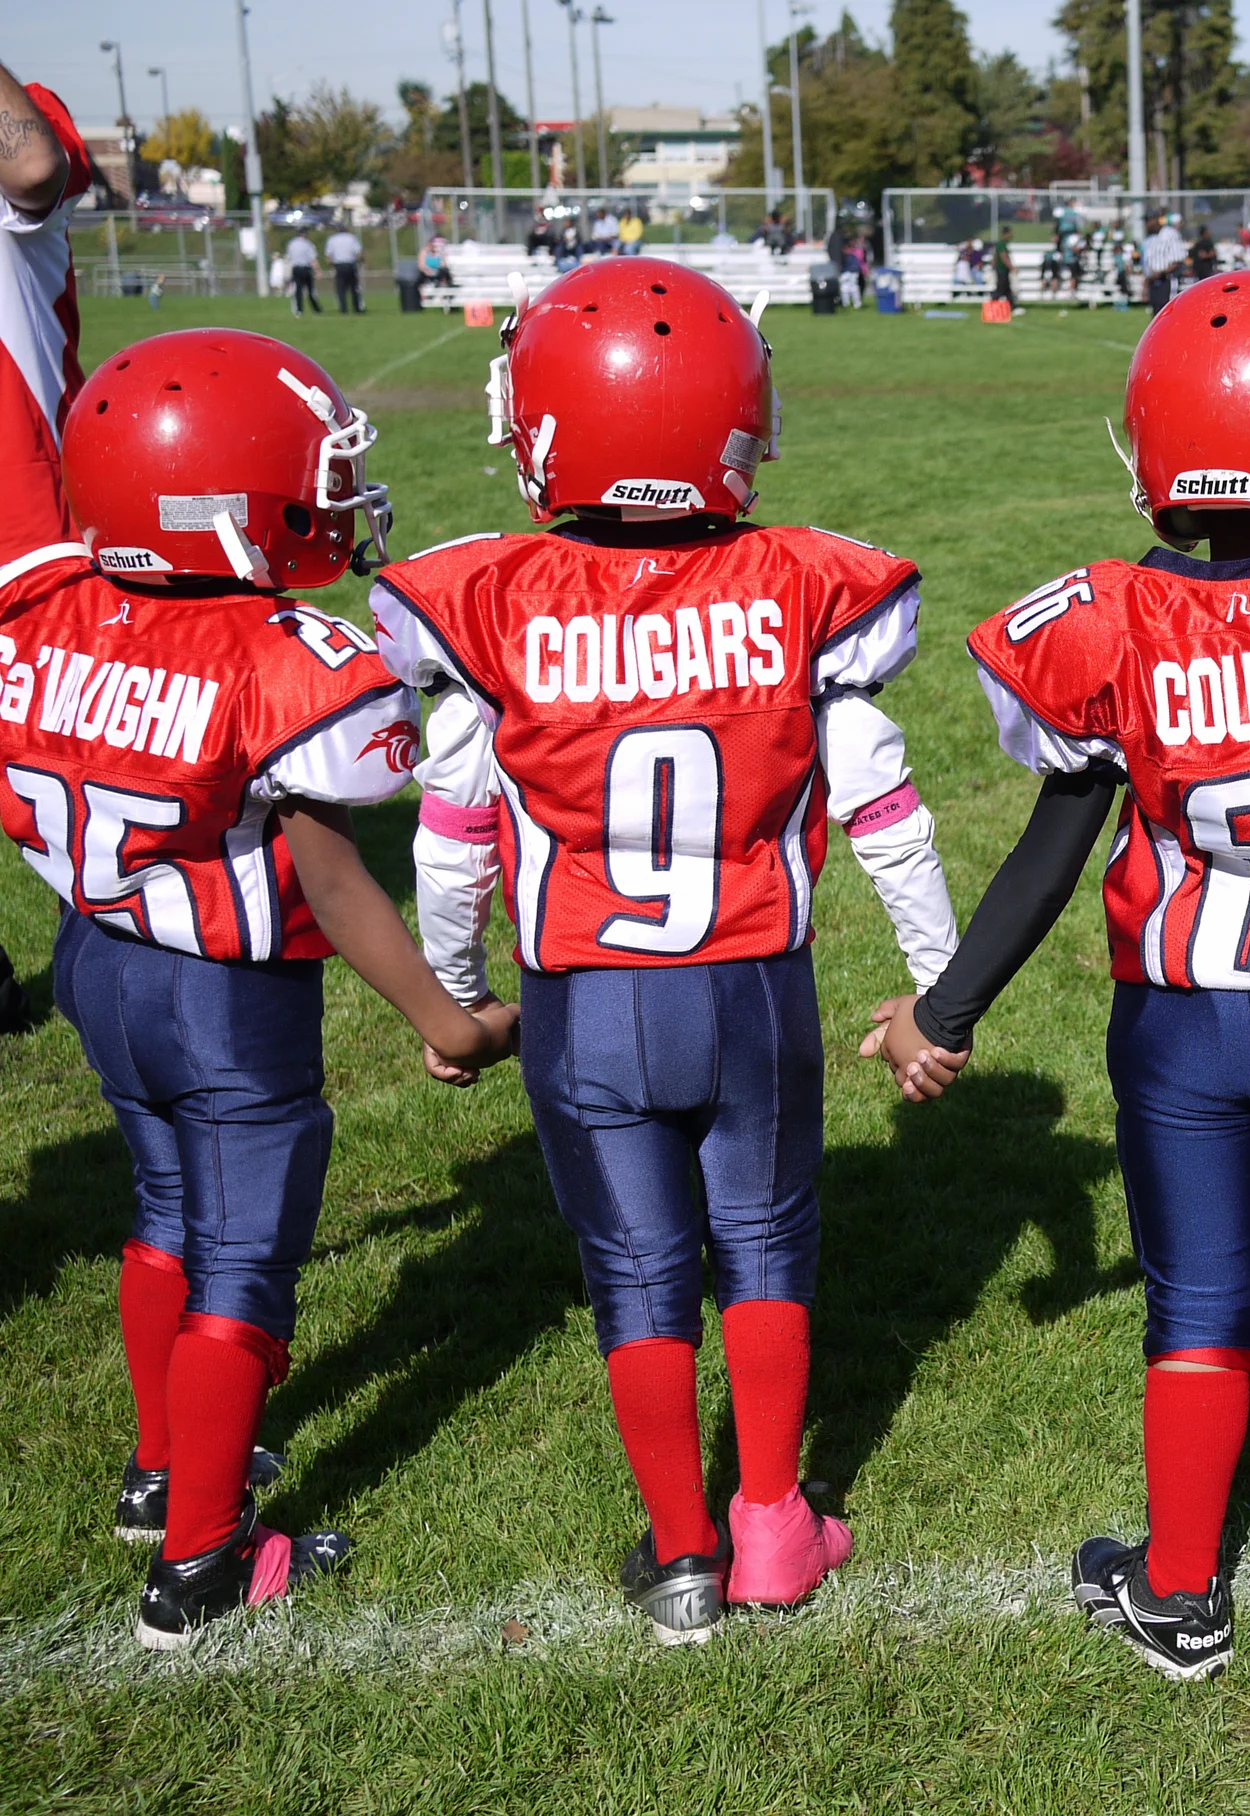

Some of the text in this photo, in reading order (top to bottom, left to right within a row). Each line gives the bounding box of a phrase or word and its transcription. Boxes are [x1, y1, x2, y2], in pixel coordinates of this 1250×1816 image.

[612, 483, 692, 505] schutt
[1176, 475, 1249, 496] schutt
[100, 551, 153, 569] schutt
[525, 599, 785, 703] COUGARS
[594, 722, 724, 957] 9
[654, 1586, 708, 1630] NIKE
